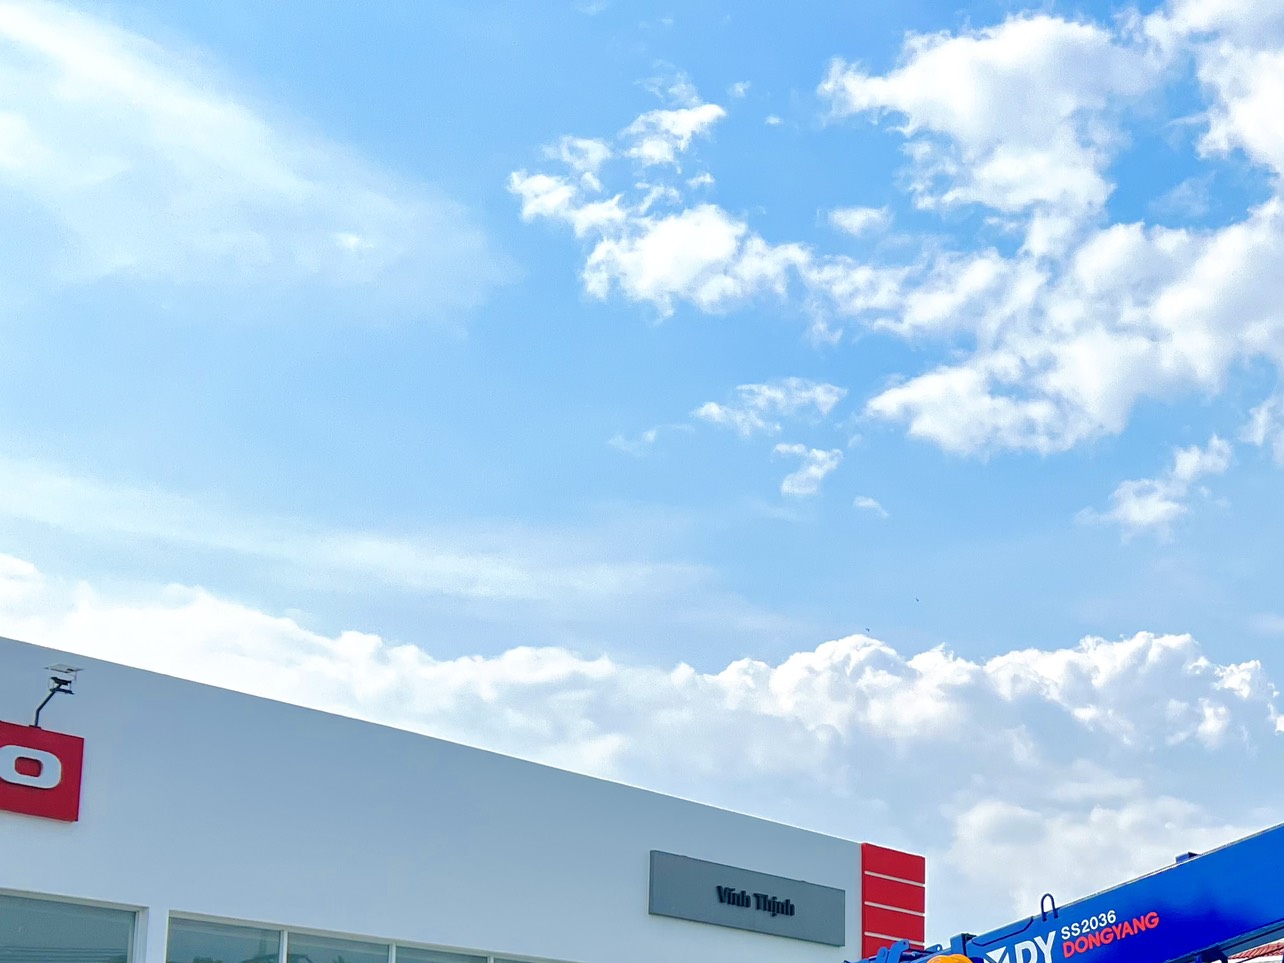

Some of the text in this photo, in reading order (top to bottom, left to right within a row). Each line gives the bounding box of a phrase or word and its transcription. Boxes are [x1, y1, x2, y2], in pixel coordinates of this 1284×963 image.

[753, 892, 795, 917] Thịnh
[1061, 909, 1117, 940] SS2036
[1062, 911, 1160, 958] DONGYANG
